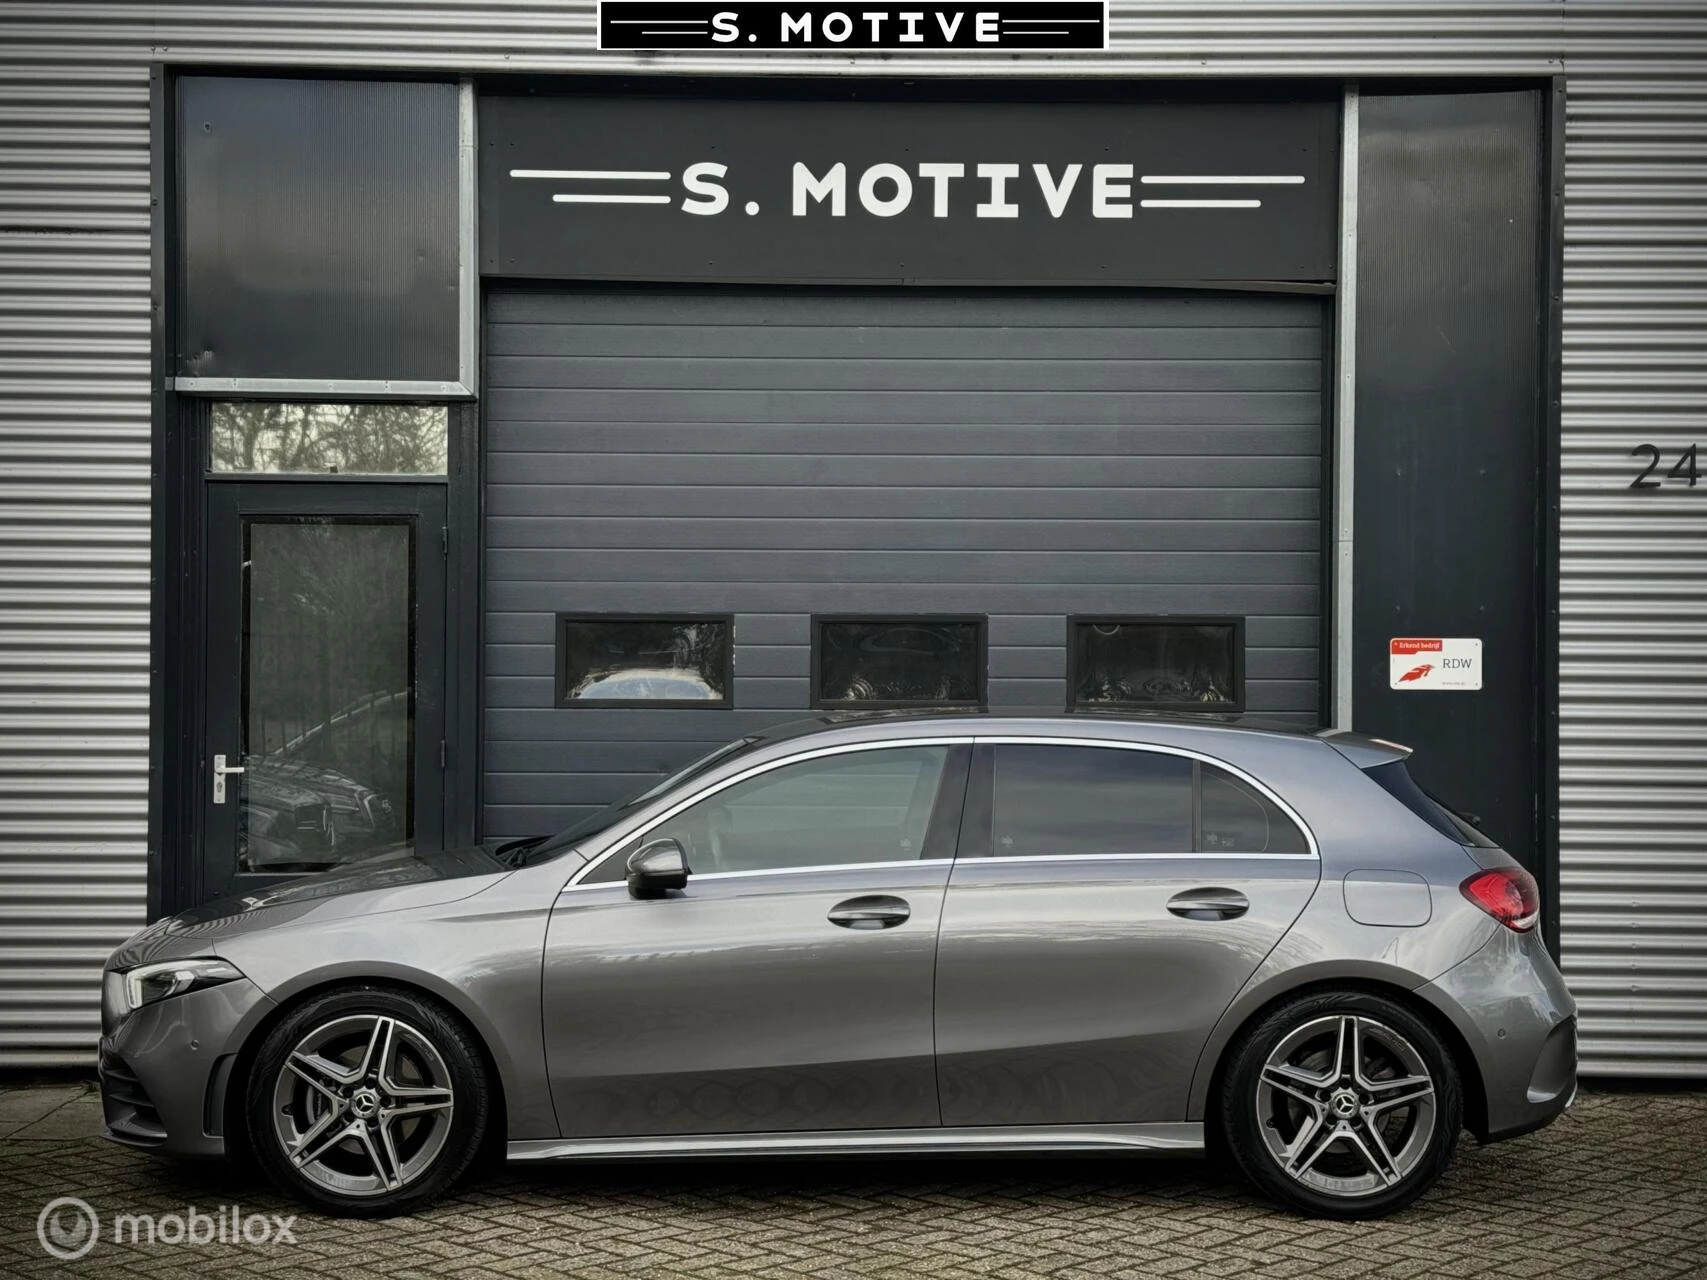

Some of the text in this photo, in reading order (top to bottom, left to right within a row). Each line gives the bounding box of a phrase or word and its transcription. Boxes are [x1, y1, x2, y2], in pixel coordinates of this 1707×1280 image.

[680, 161, 1134, 219] S. MOTIVE
[1629, 443, 1702, 488] 24
[1442, 658, 1472, 669] RDW
